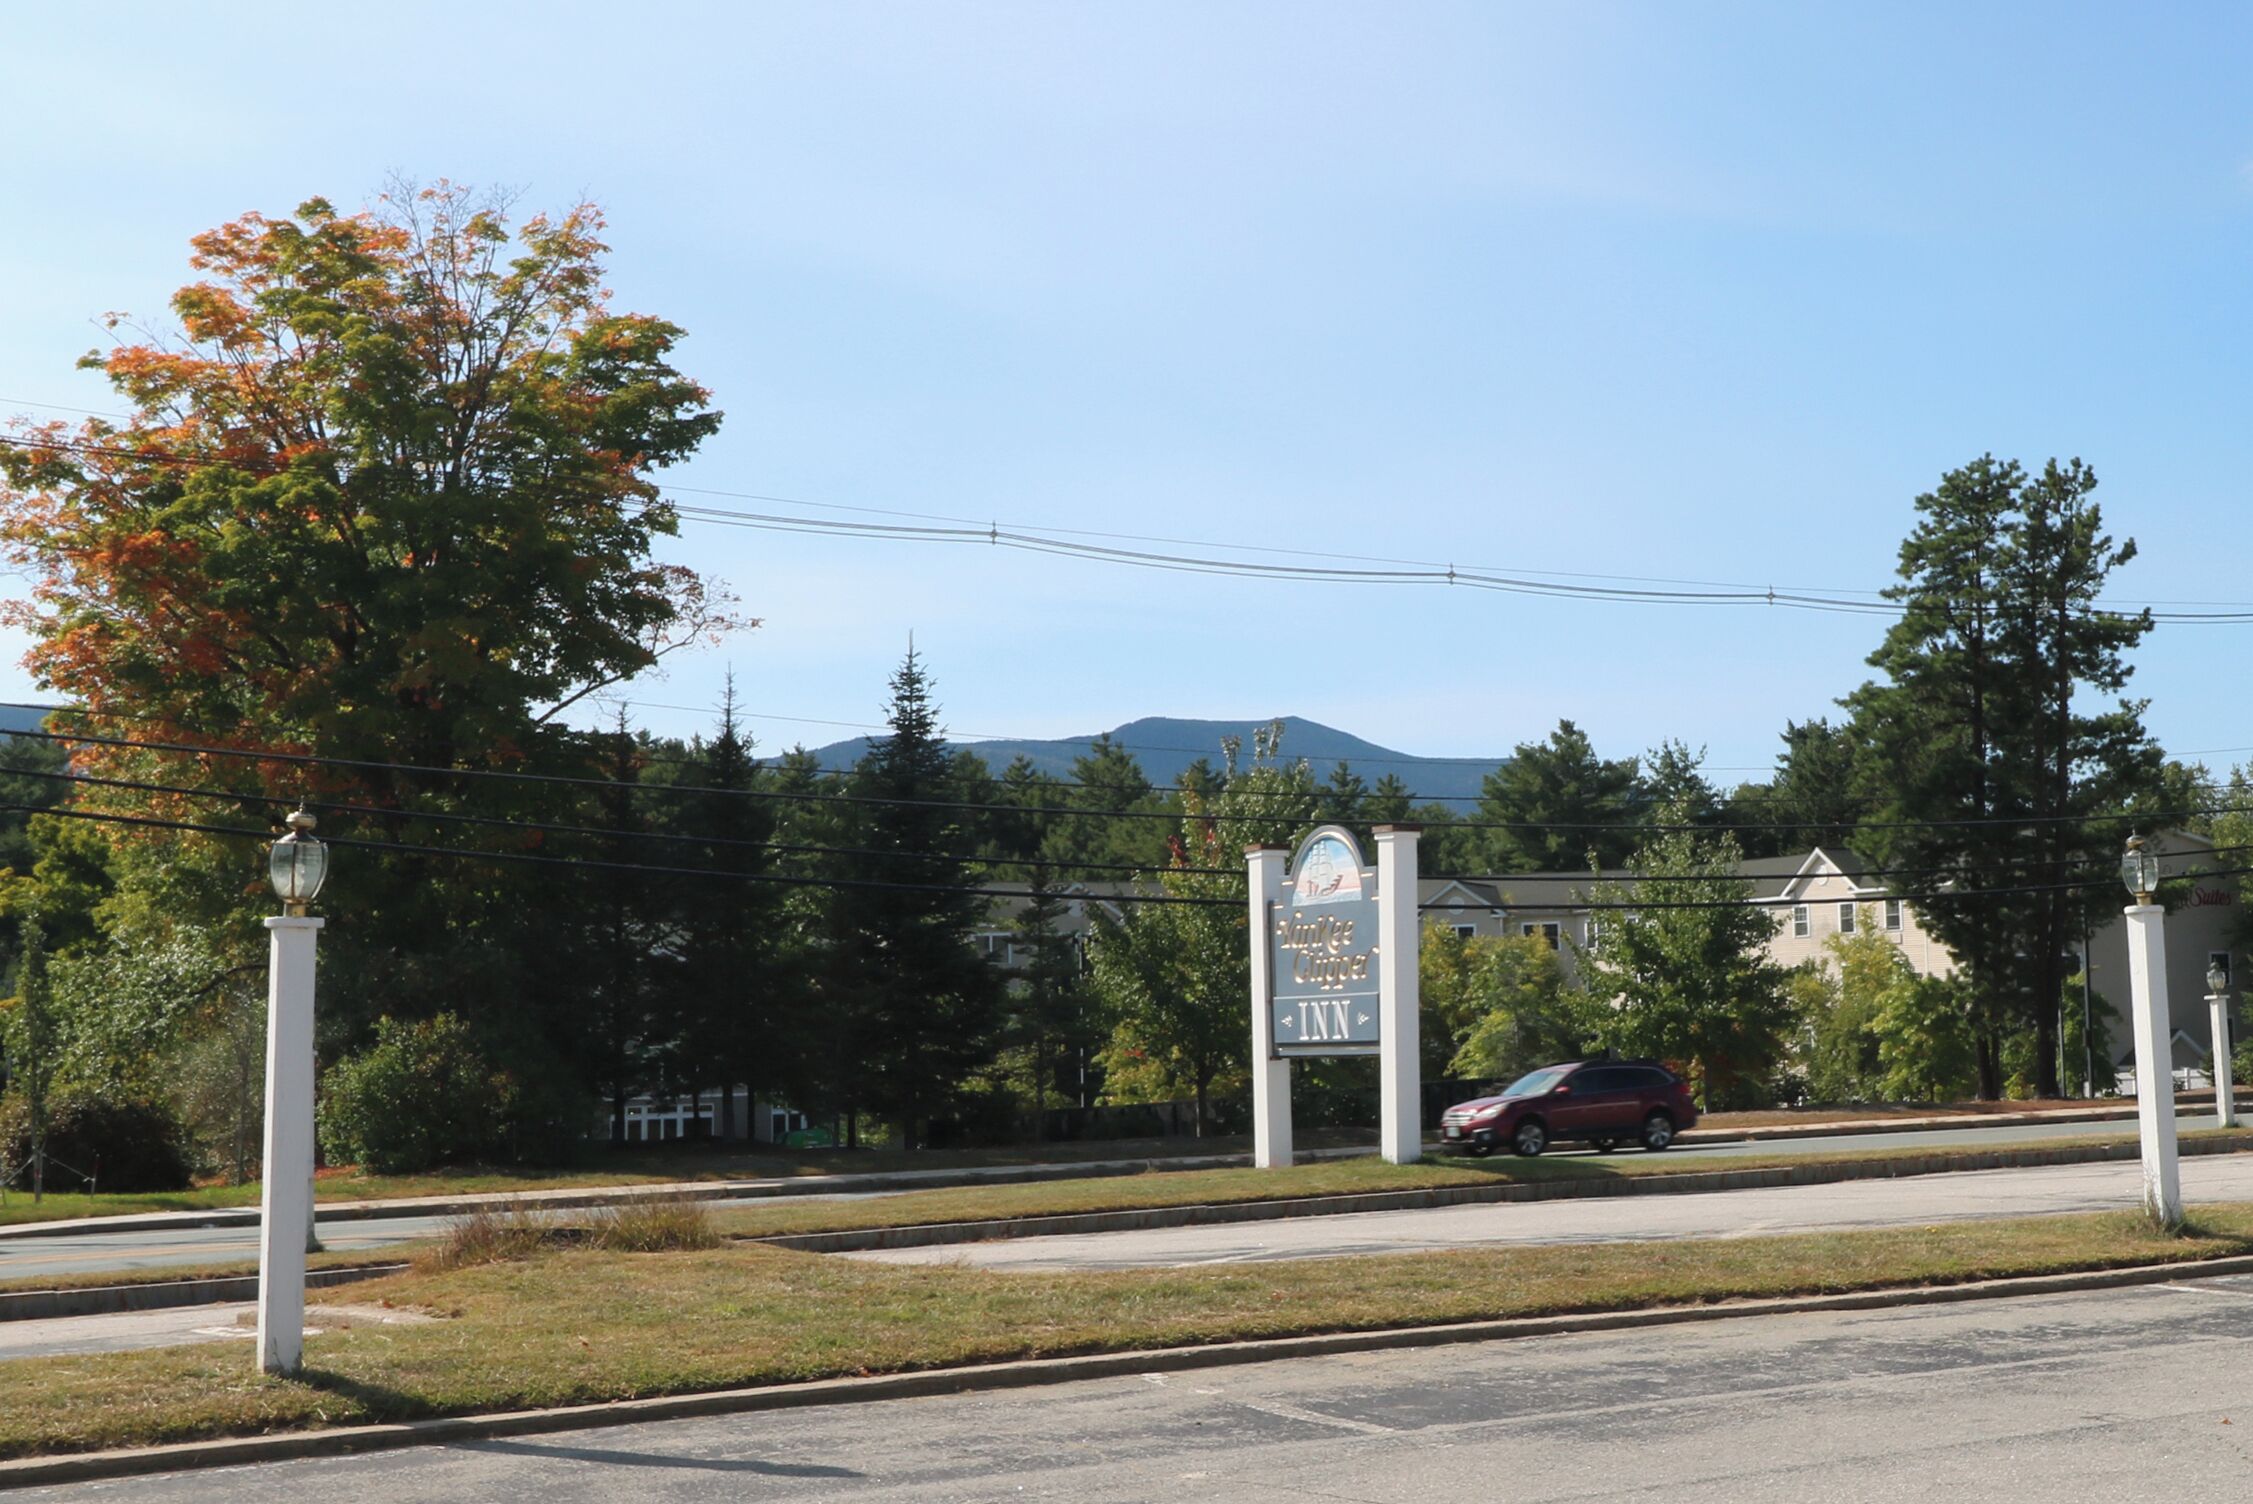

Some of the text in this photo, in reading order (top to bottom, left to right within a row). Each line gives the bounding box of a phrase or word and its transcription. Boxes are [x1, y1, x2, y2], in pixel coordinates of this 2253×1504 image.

[2191, 887, 2231, 907] Suites
[1294, 946, 1379, 990] Clipper
[1298, 1000, 1350, 1040] INN
